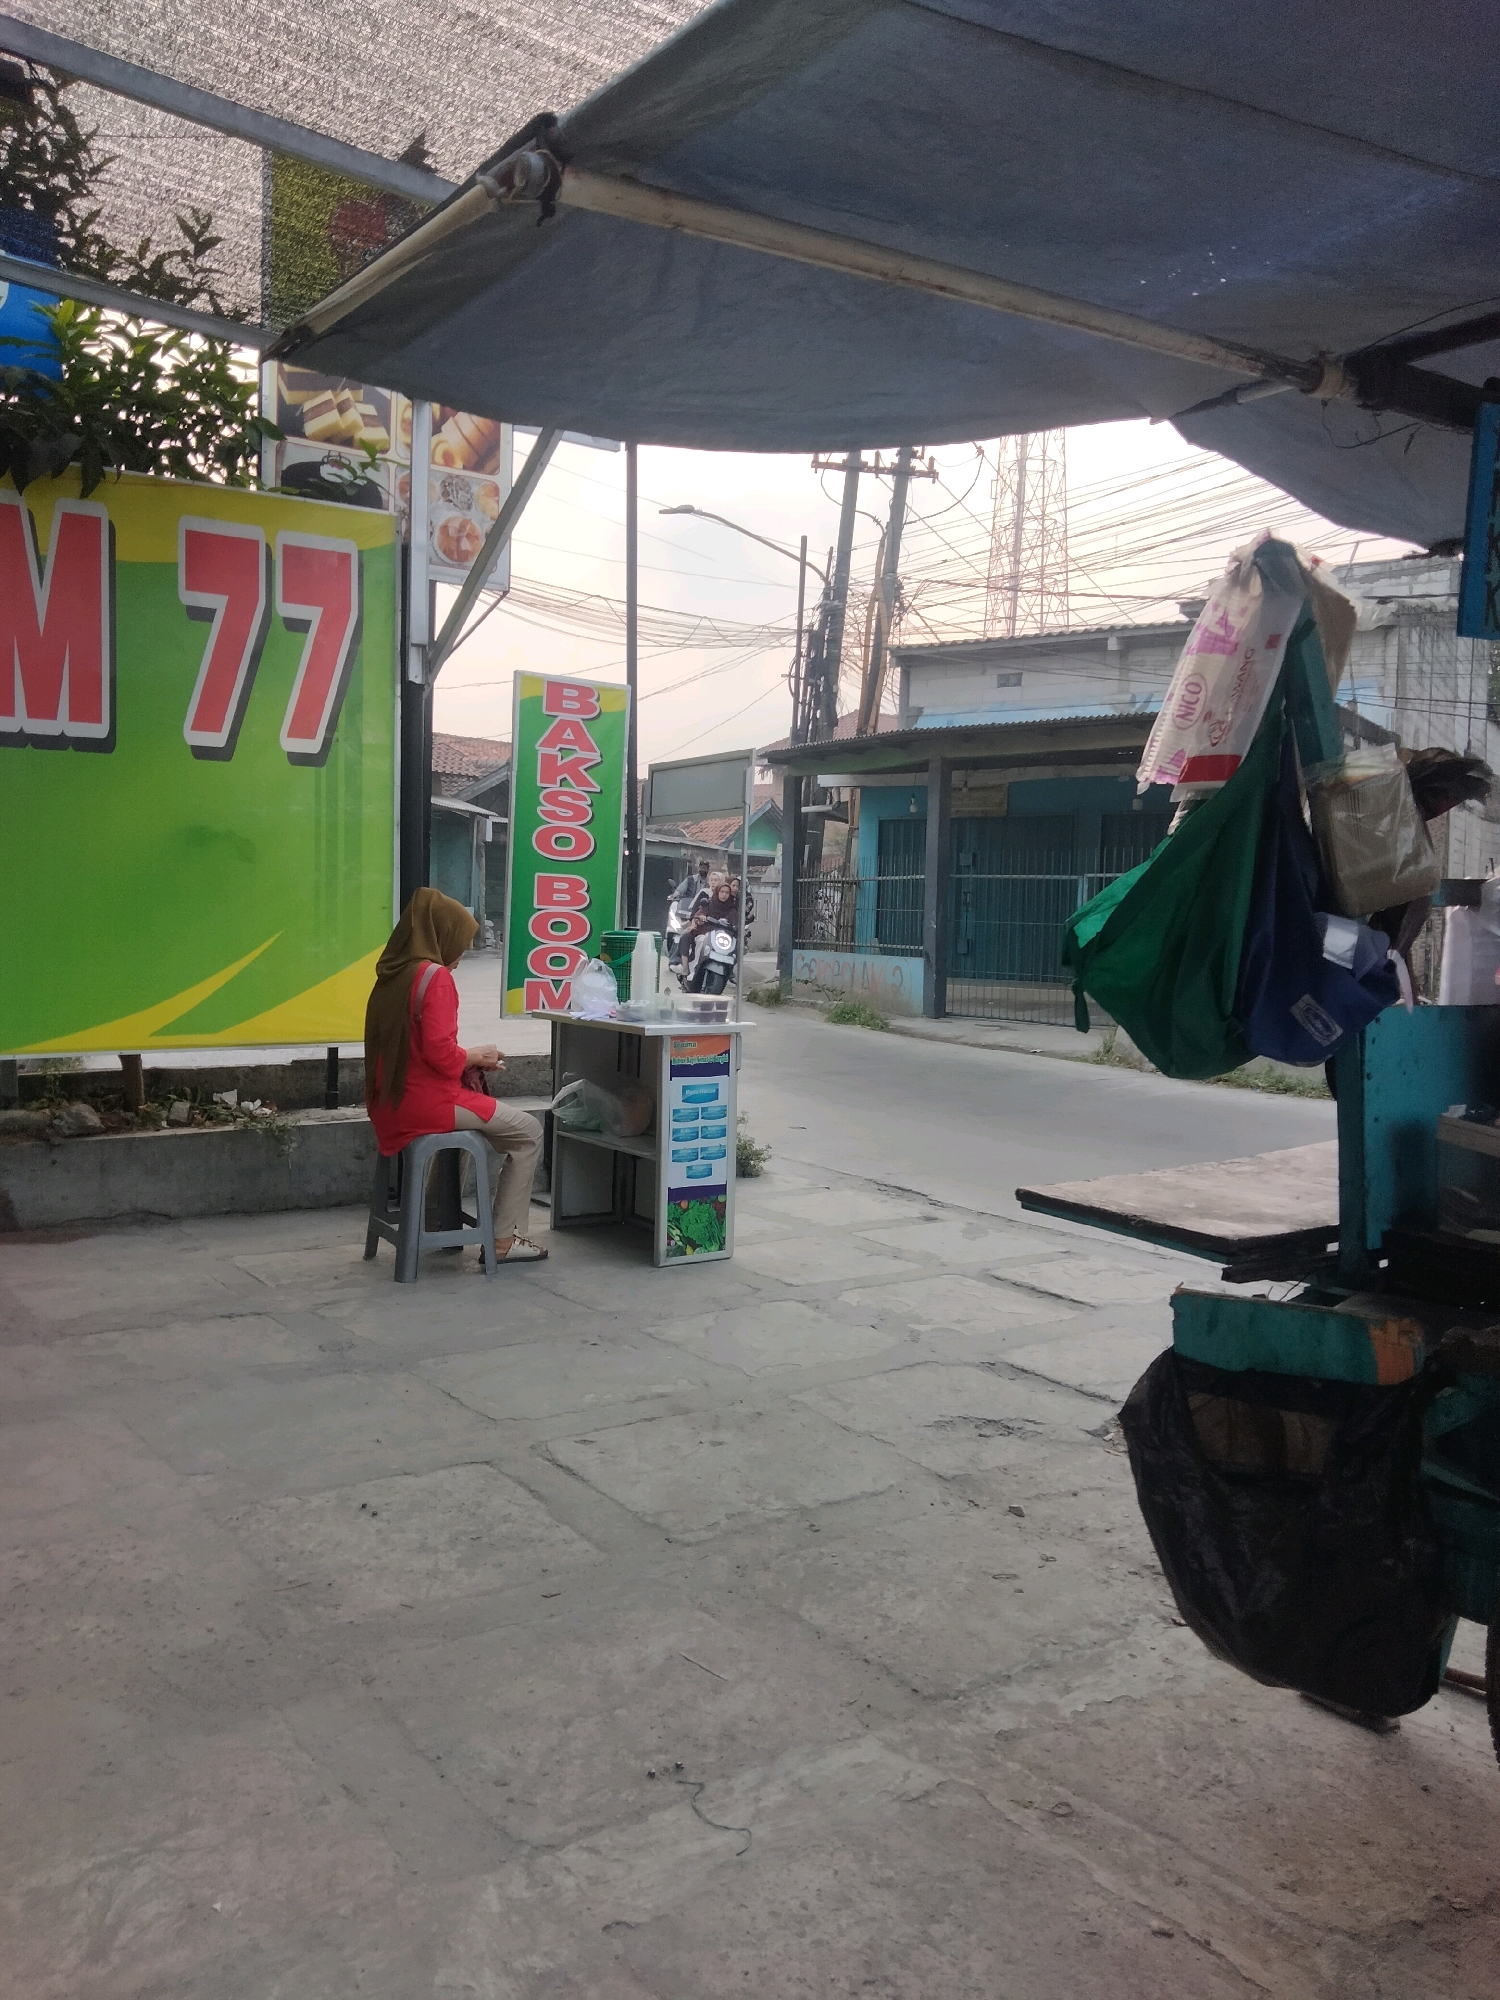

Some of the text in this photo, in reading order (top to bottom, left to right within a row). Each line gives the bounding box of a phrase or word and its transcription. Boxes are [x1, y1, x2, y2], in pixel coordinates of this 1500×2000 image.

[178, 515, 362, 767] 77
[1175, 681, 1203, 722] NICO
[523, 679, 603, 1014] BAKSO BOOM
